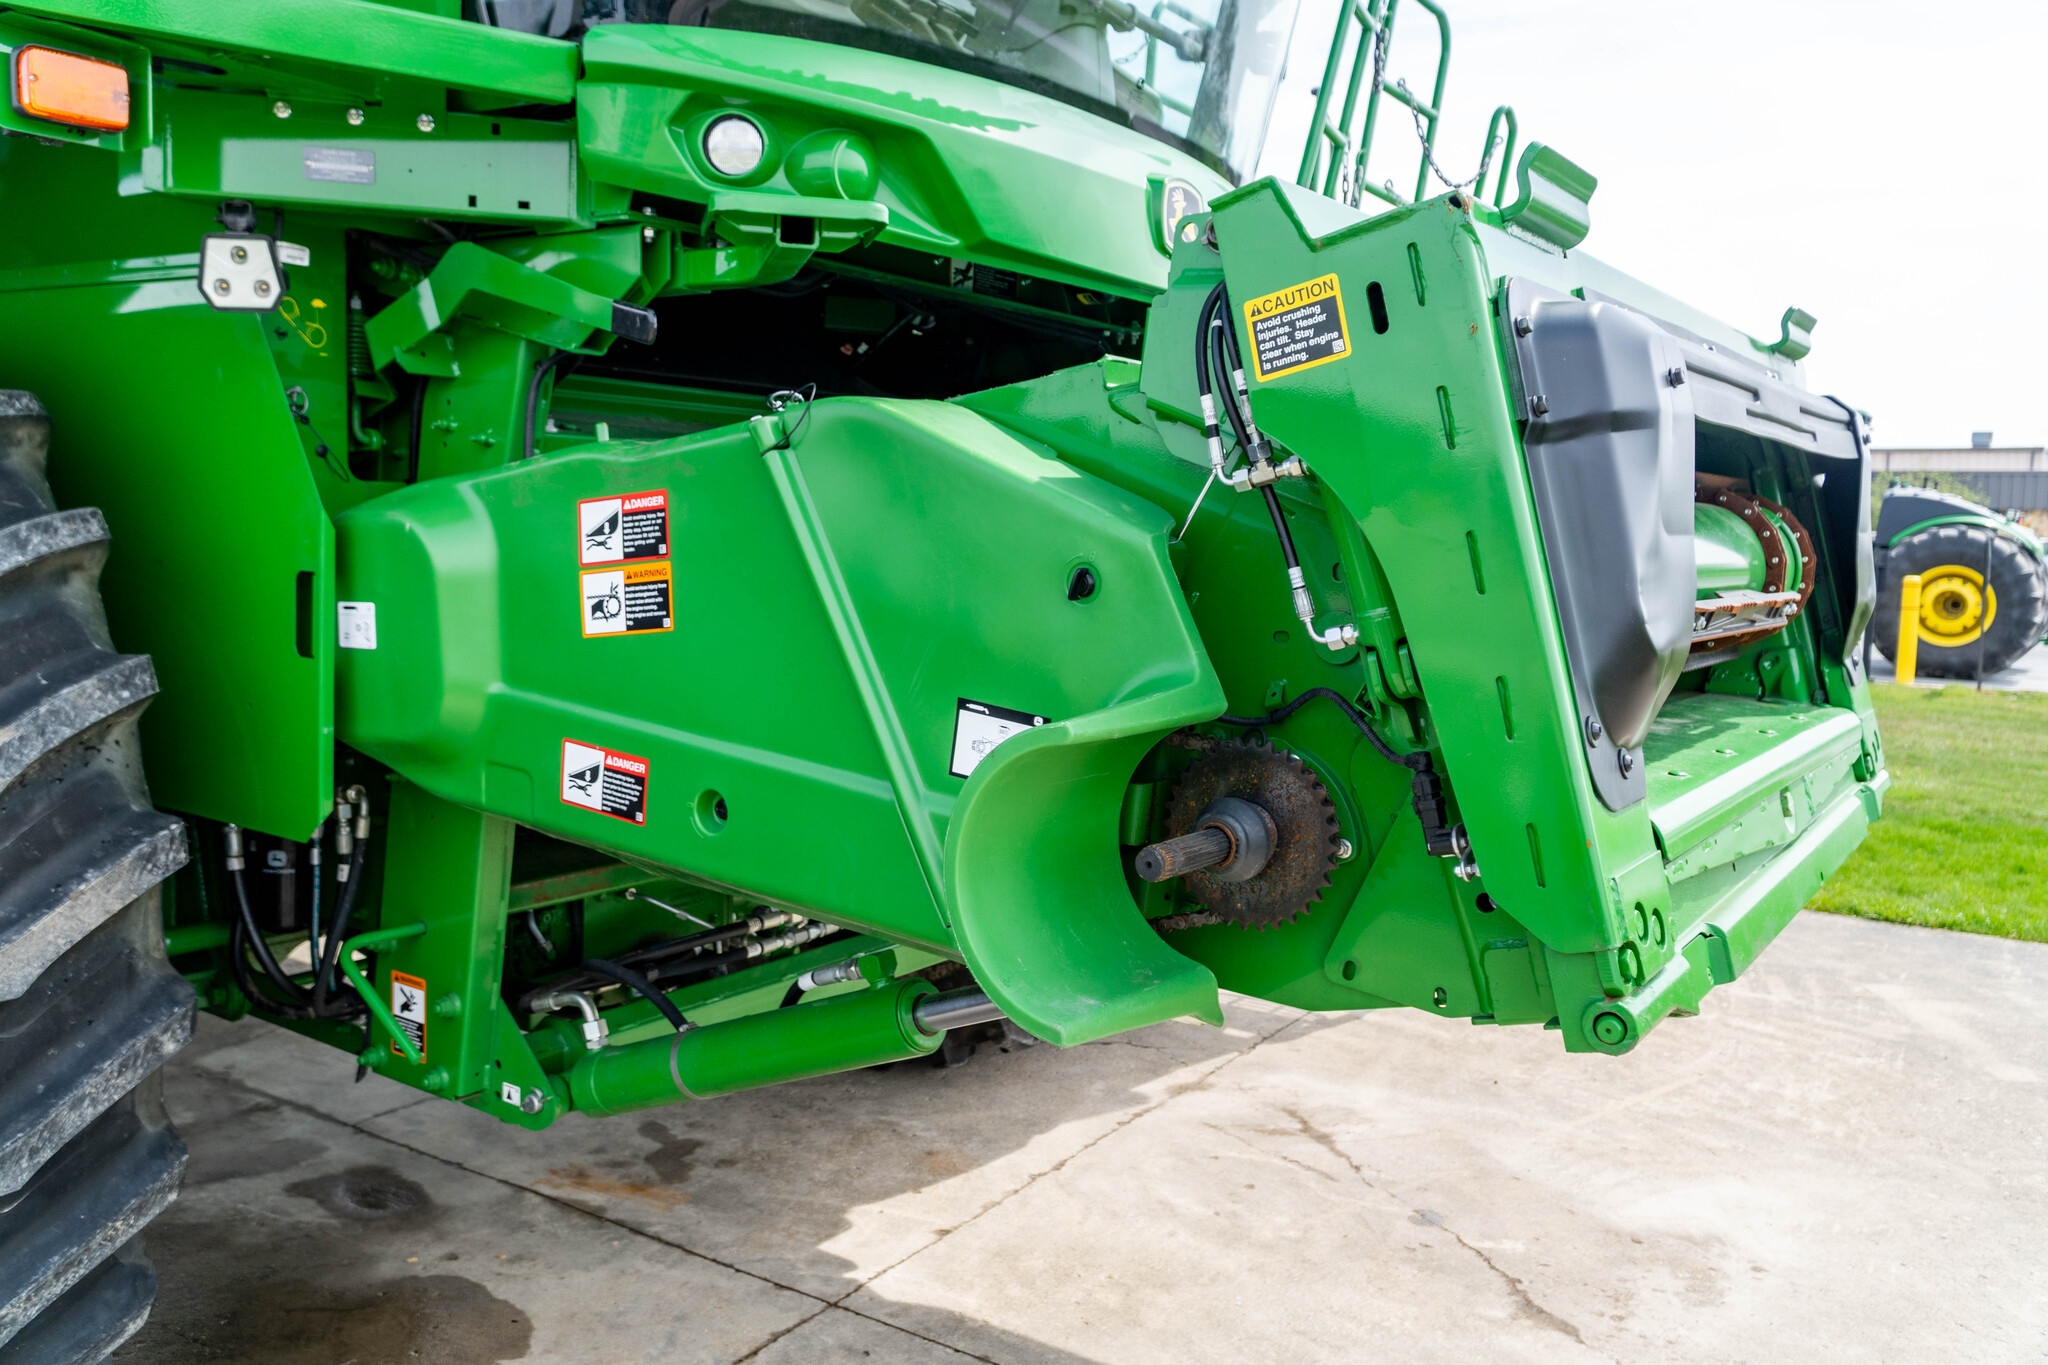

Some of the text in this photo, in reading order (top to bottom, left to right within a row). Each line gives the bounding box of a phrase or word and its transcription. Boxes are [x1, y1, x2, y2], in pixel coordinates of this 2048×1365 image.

[1262, 278, 1335, 313] CAUTION
[1256, 304, 1322, 331] Avoid crushing
[1257, 313, 1327, 342] injuries. Header
[1259, 327, 1315, 351] can tilt. Stay
[1261, 331, 1339, 361] clear when engine
[1263, 351, 1310, 371] is running.
[630, 495, 665, 510] DANGER
[632, 567, 668, 579] WARNING
[612, 756, 646, 774] DANGER
